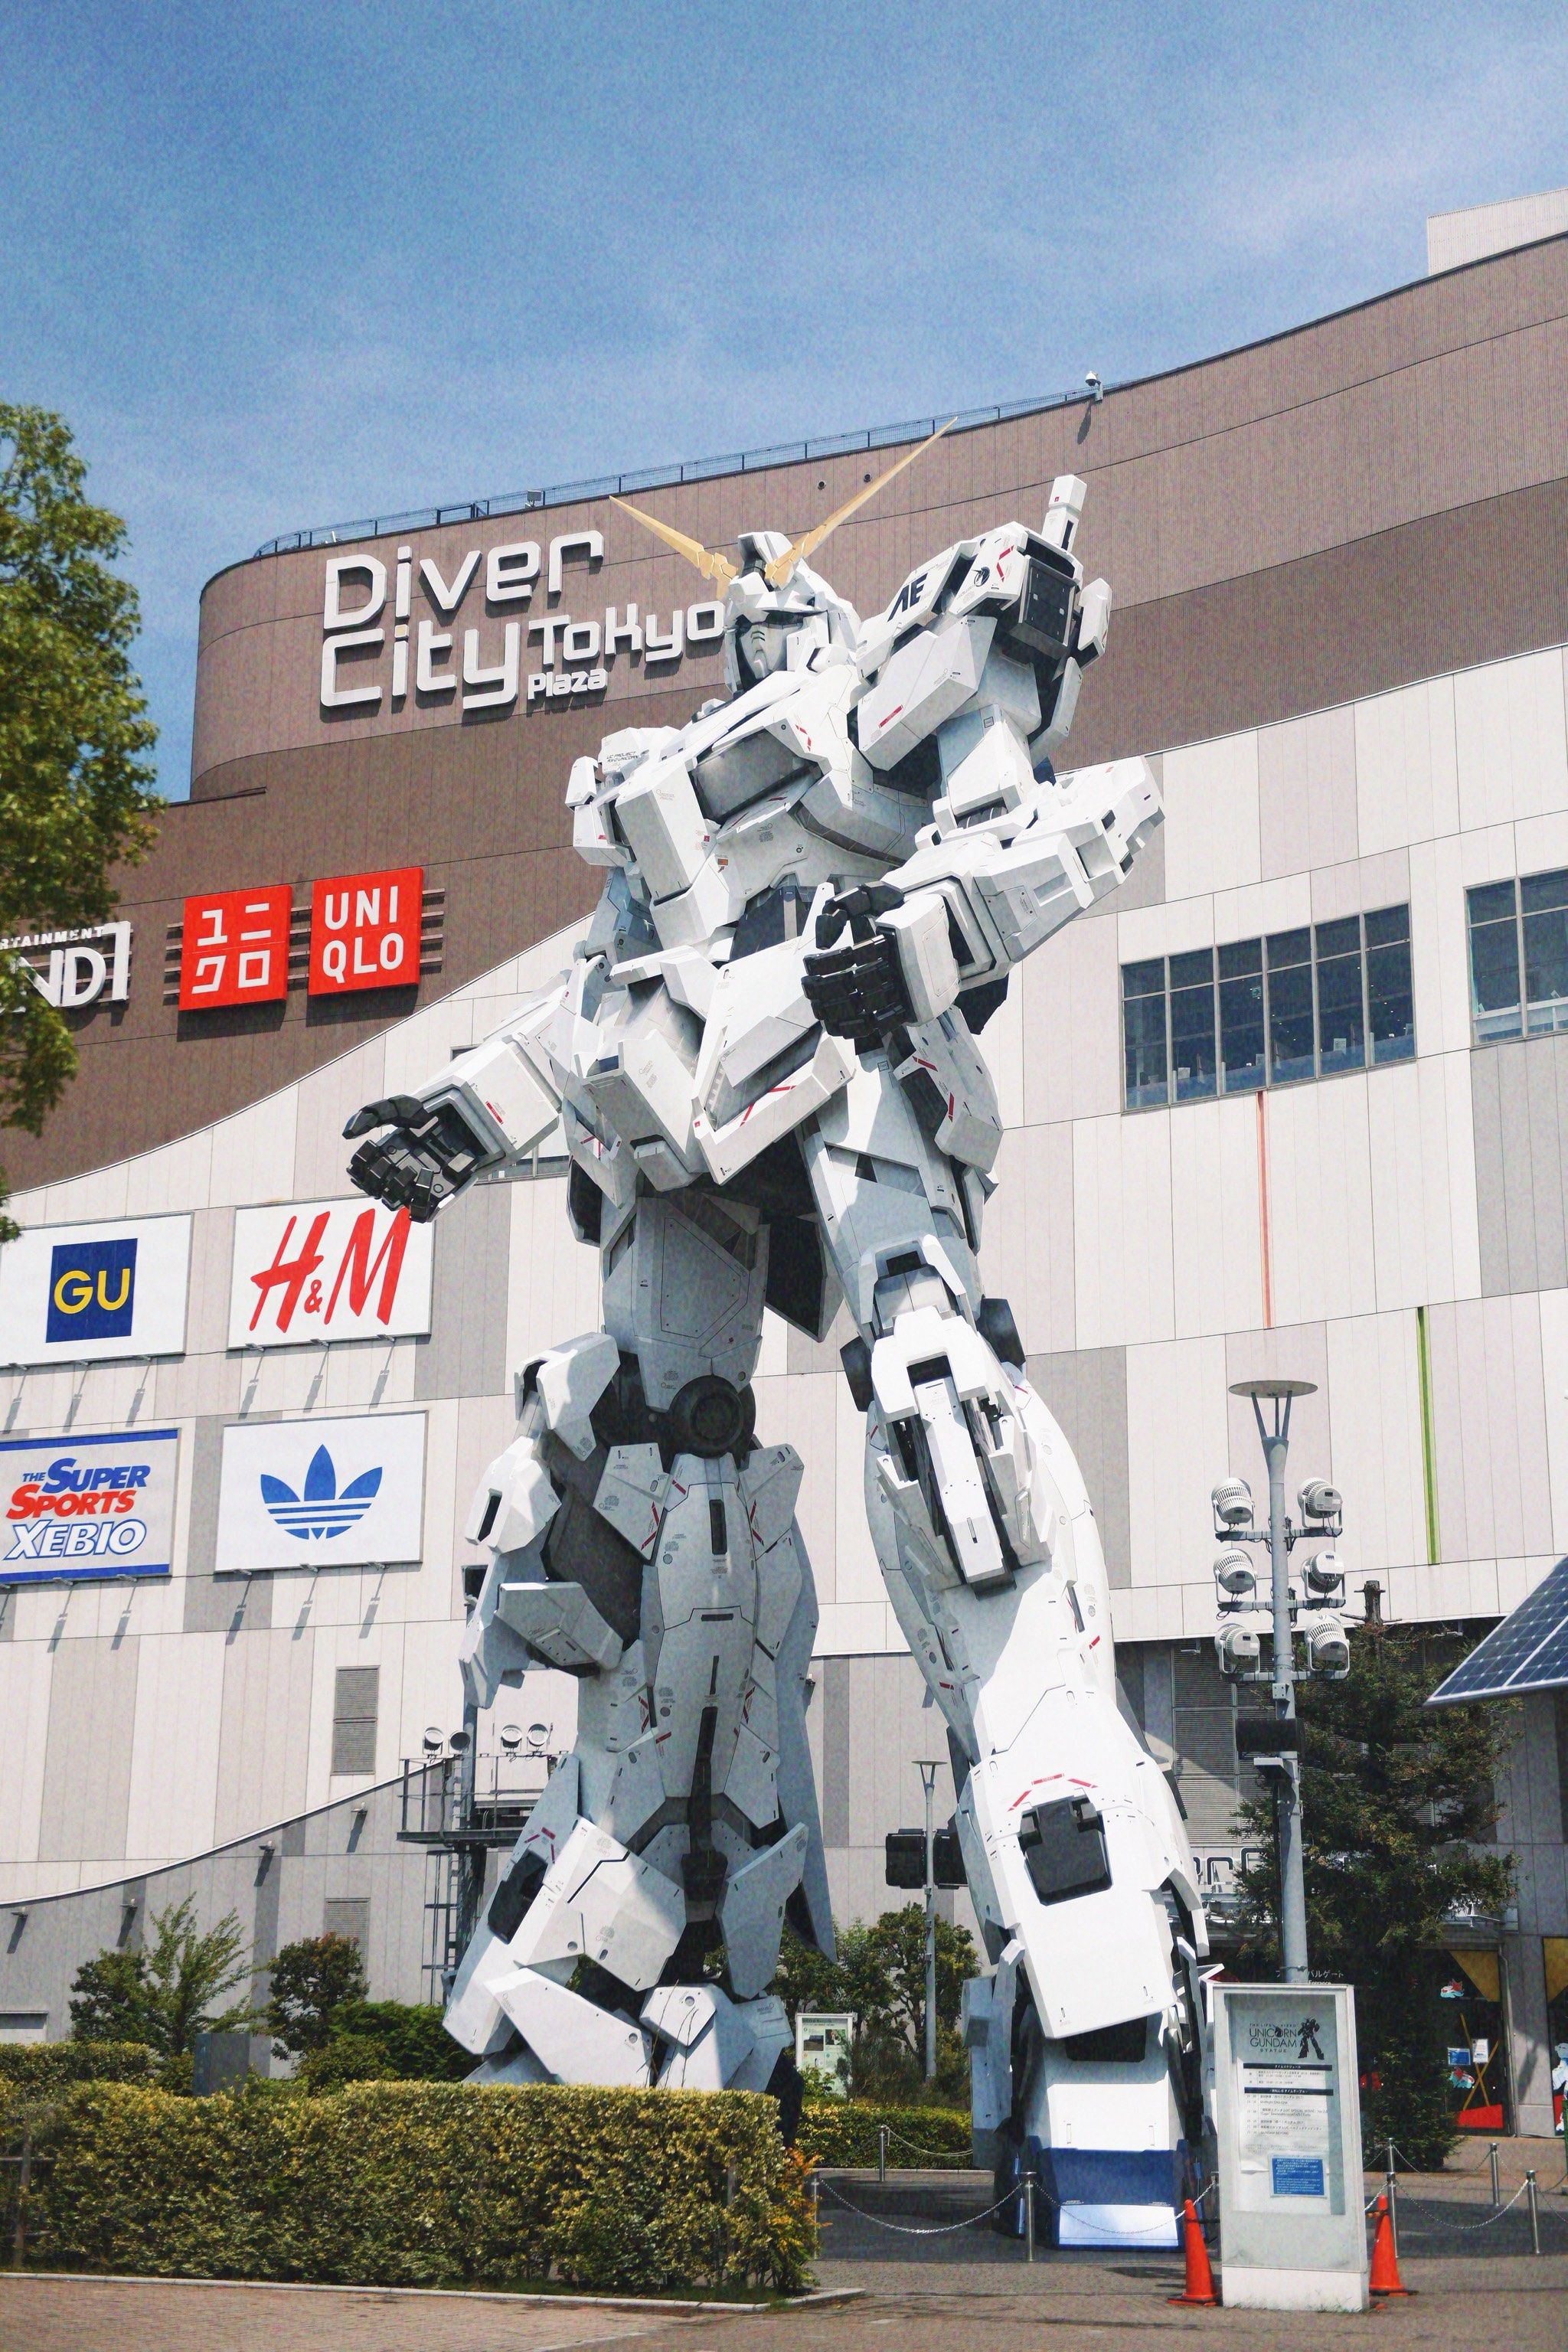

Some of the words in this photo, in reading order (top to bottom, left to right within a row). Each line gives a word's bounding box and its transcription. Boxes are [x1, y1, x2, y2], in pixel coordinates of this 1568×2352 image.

[323, 530, 604, 630] Diver
[320, 619, 521, 710] City
[528, 599, 726, 667] Tokyo
[197, 902, 272, 947] ユニ
[325, 885, 399, 930] UNI
[191, 949, 271, 995] クロ
[322, 932, 404, 985] QLO
[54, 1268, 131, 1315] GU
[249, 1208, 412, 1333] H&M
[22, 1472, 47, 1482] THE
[41, 1458, 152, 1494] SUPER
[5, 1484, 137, 1520] SPORTS
[2, 1518, 148, 1561] XEBIO
[1250, 2028, 1297, 2038] UNICORN
[1250, 2037, 1297, 2048] GUNDAM
